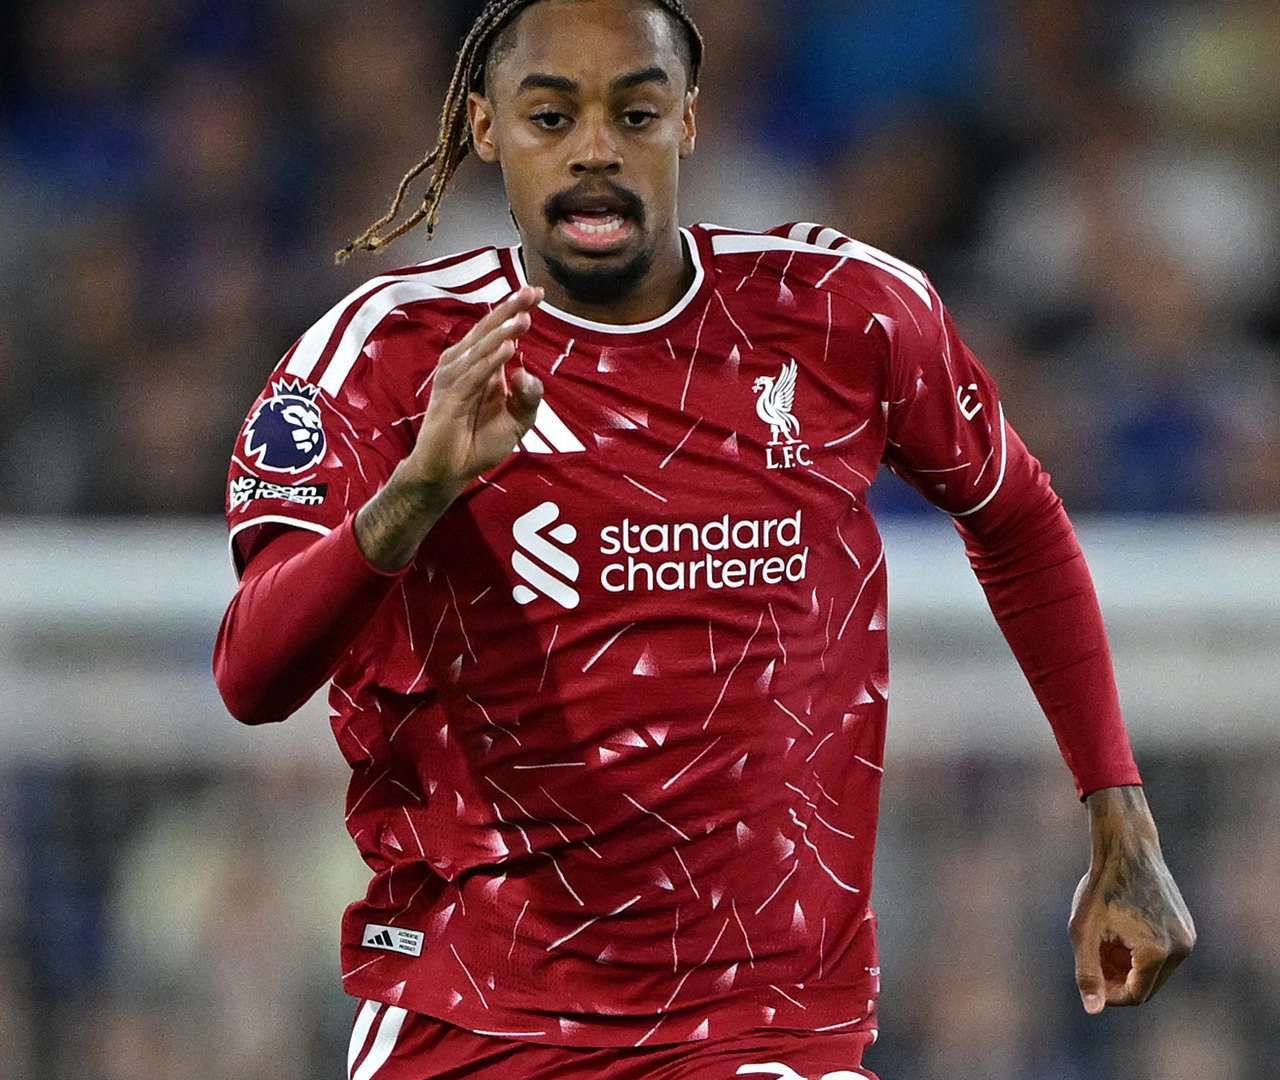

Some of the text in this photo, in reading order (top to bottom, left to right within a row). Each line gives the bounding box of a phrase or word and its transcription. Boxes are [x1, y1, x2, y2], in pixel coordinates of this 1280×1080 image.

[765, 444, 814, 469] L.F.C.
[230, 476, 317, 496] No room
[255, 488, 324, 505] racism
[600, 509, 802, 555] standard
[600, 546, 809, 592] chartered
